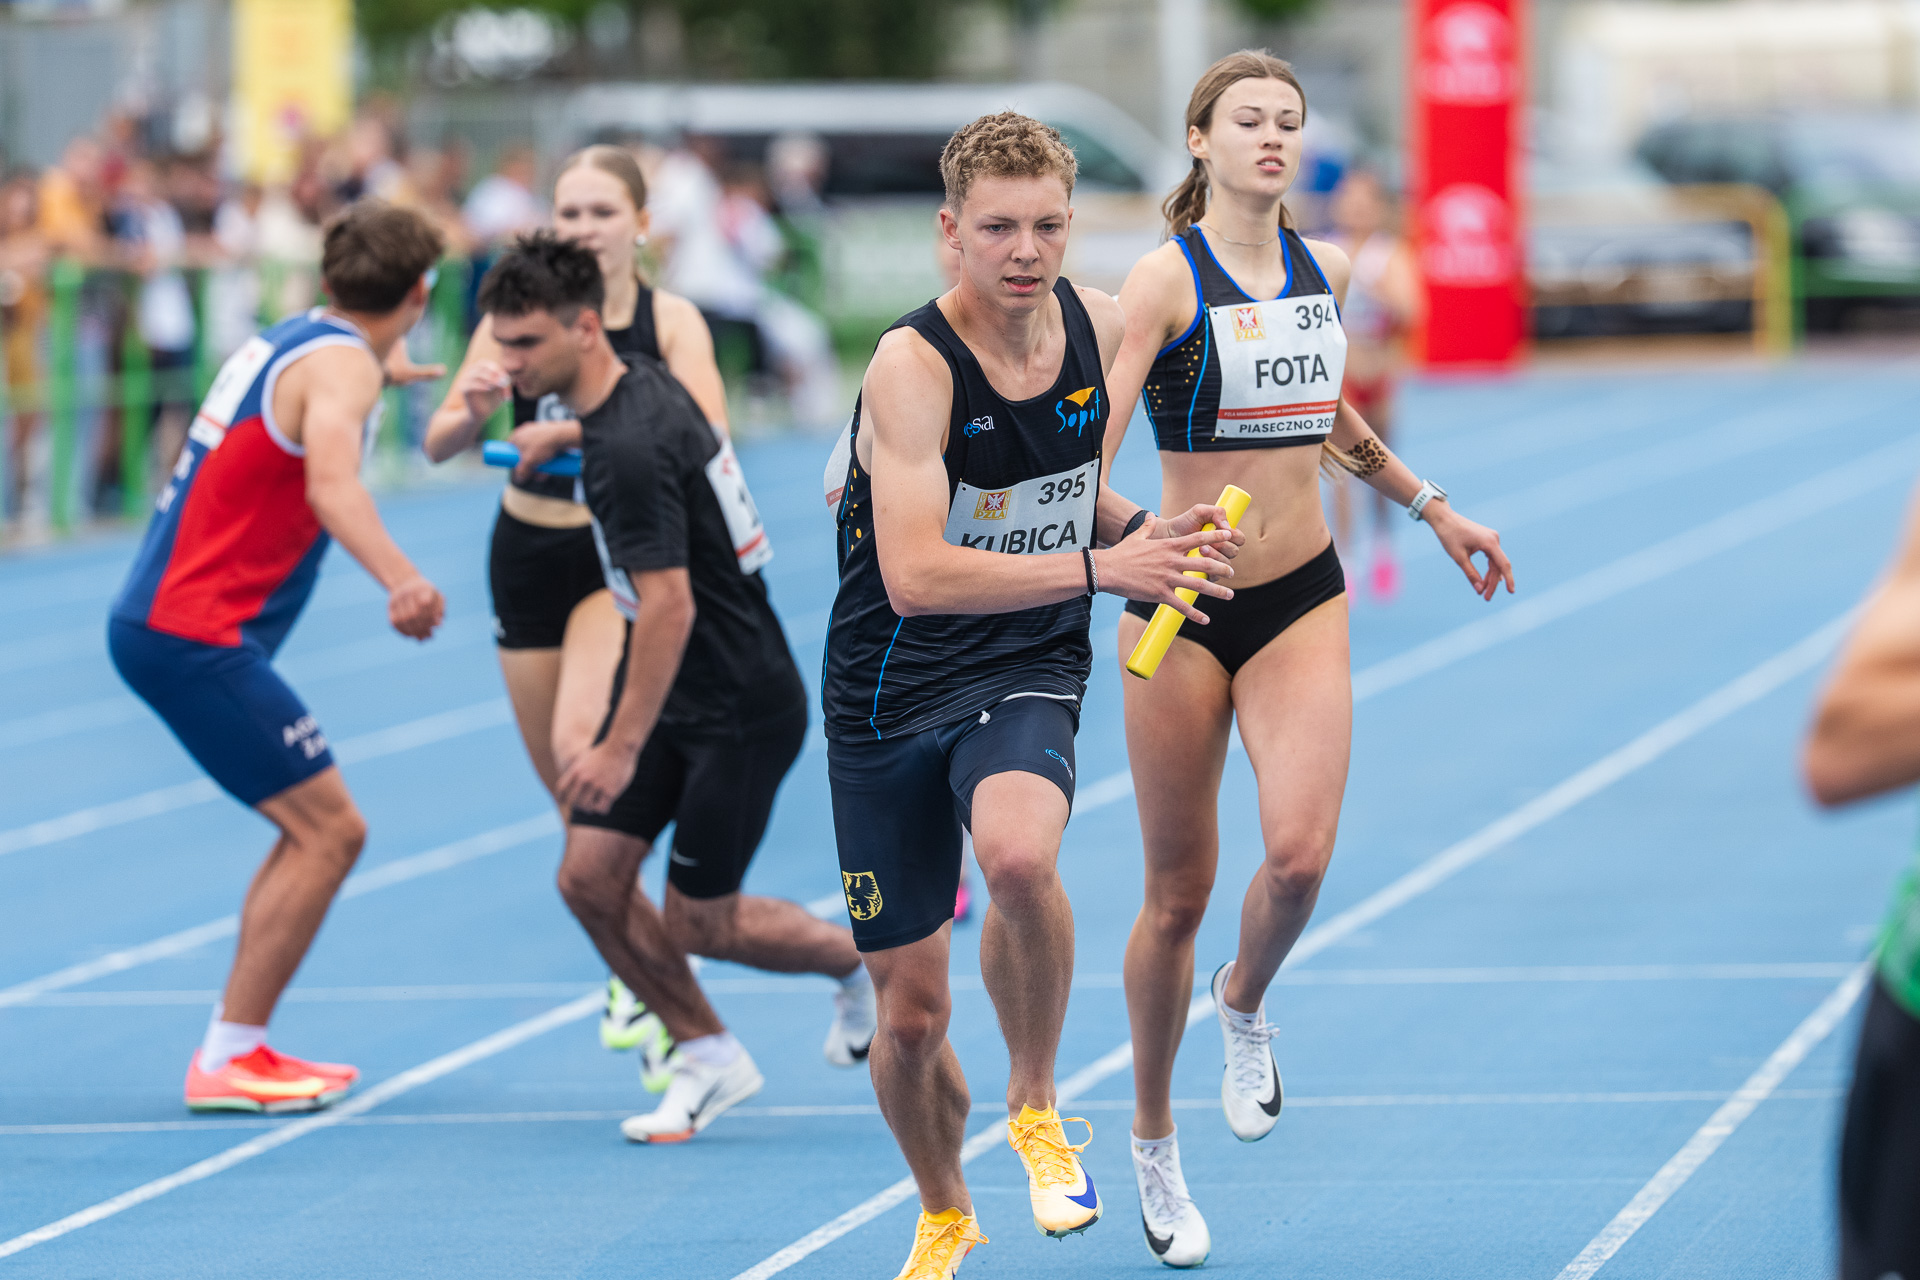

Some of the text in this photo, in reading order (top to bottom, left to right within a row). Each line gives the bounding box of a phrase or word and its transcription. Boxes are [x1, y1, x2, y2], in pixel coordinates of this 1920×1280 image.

[1295, 303, 1334, 330] 394
[1255, 354, 1329, 389] FOTA
[1056, 389, 1100, 437] Sopot
[1239, 419, 1313, 433] PIASECZNO
[1038, 471, 1086, 505] 395
[976, 510, 1005, 519] PZLA
